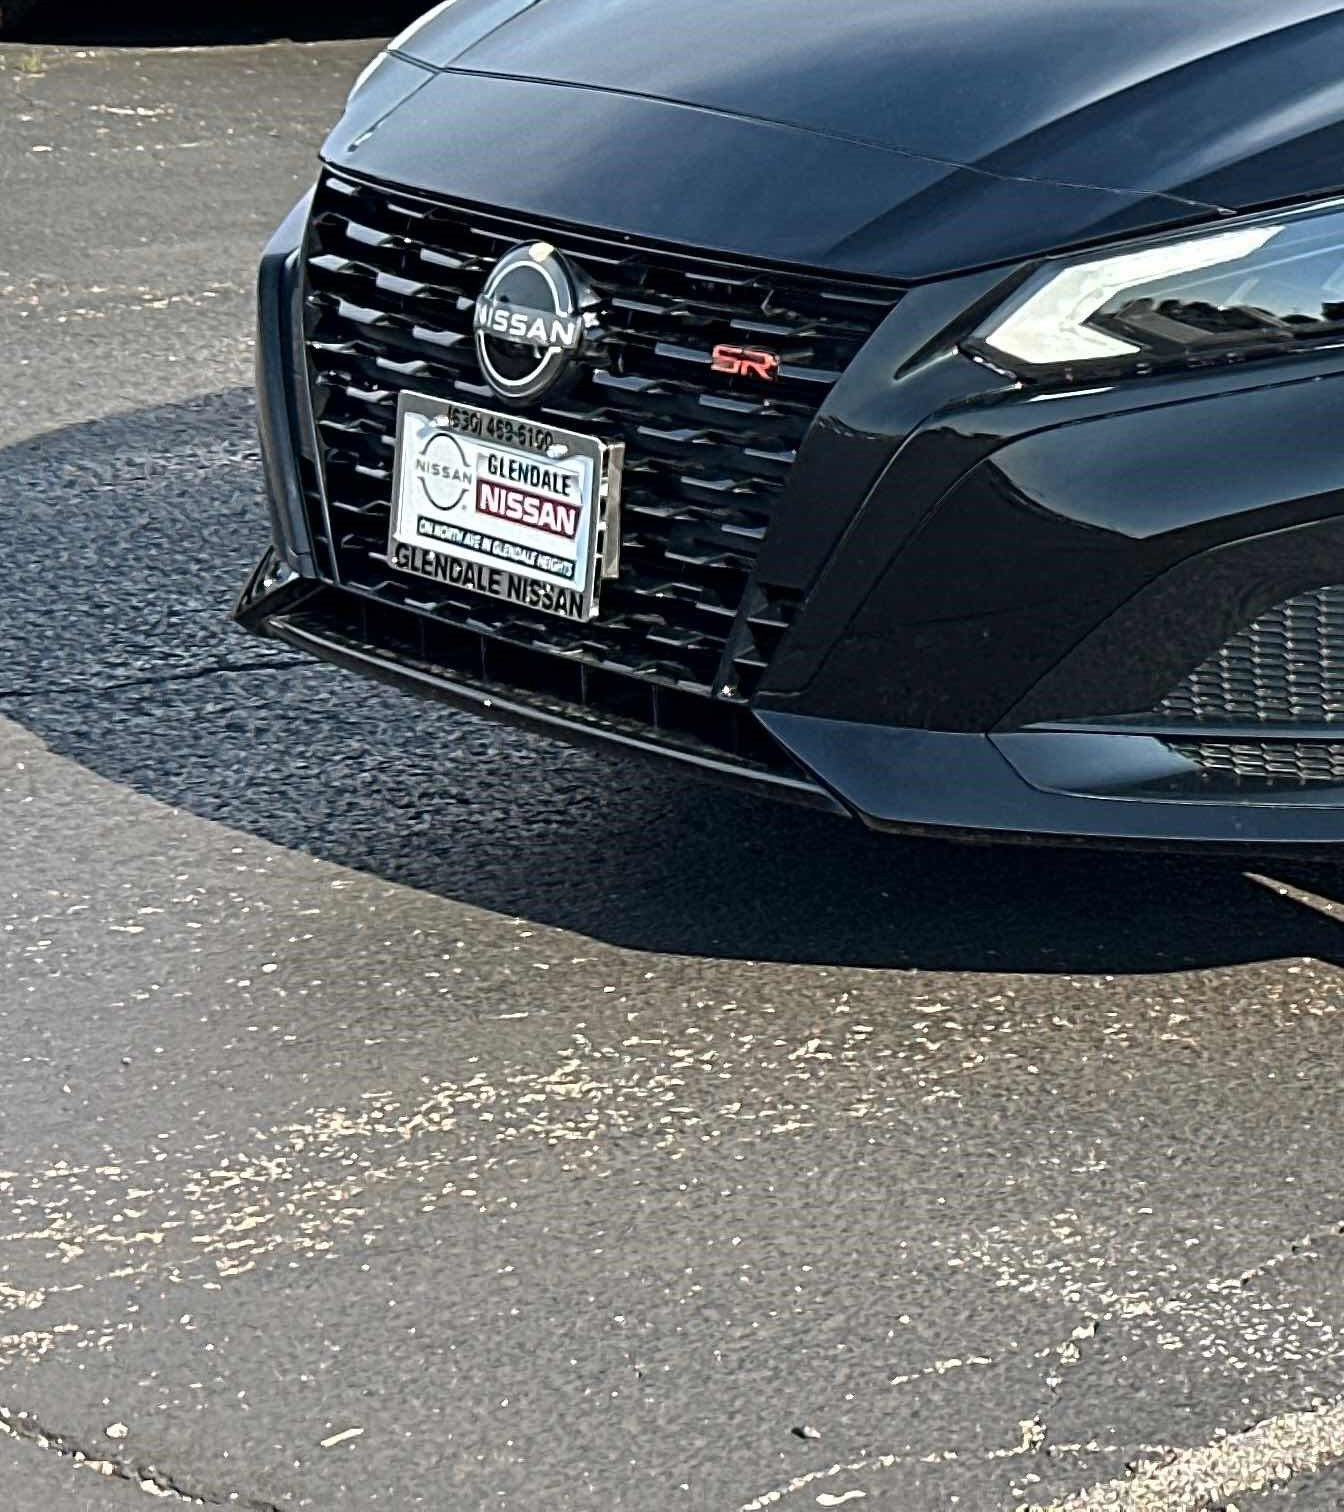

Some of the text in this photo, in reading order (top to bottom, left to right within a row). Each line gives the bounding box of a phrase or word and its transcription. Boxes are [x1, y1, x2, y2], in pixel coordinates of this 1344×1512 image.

[474, 304, 575, 346] NISSAN
[711, 343, 778, 381] SR
[416, 458, 472, 486] NISSAN
[487, 453, 571, 497] GLENDALE
[479, 483, 575, 536] NISSAN
[394, 543, 584, 620] GLENDALE NISSAN
